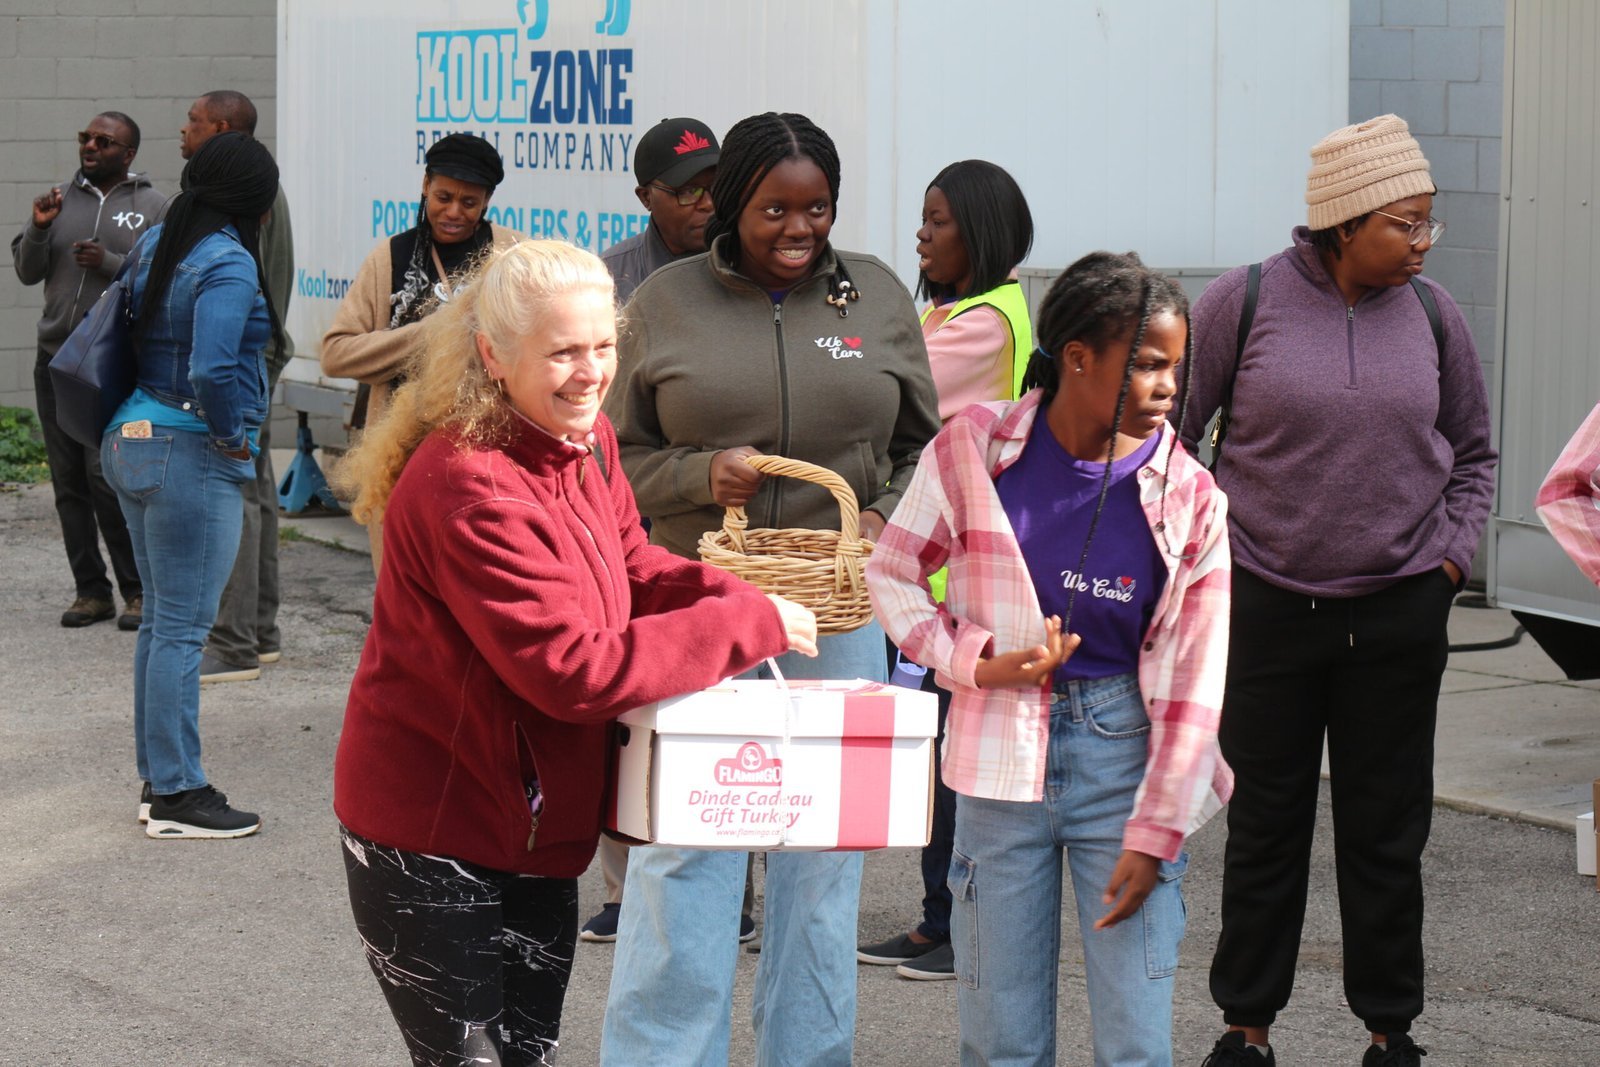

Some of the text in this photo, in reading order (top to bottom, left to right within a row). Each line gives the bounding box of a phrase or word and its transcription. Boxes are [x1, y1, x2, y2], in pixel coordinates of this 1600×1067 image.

[416, 28, 633, 125] KOOL ZONE
[515, 132, 633, 171] COMPANY
[298, 269, 354, 299] Koolzon
[813, 336, 842, 348] We
[828, 346, 864, 360] Care
[1060, 570, 1134, 603] We Care
[719, 765, 781, 783] FLAMINGO
[688, 790, 813, 807] Dinde Cadau
[700, 807, 801, 829] Gift Turky
